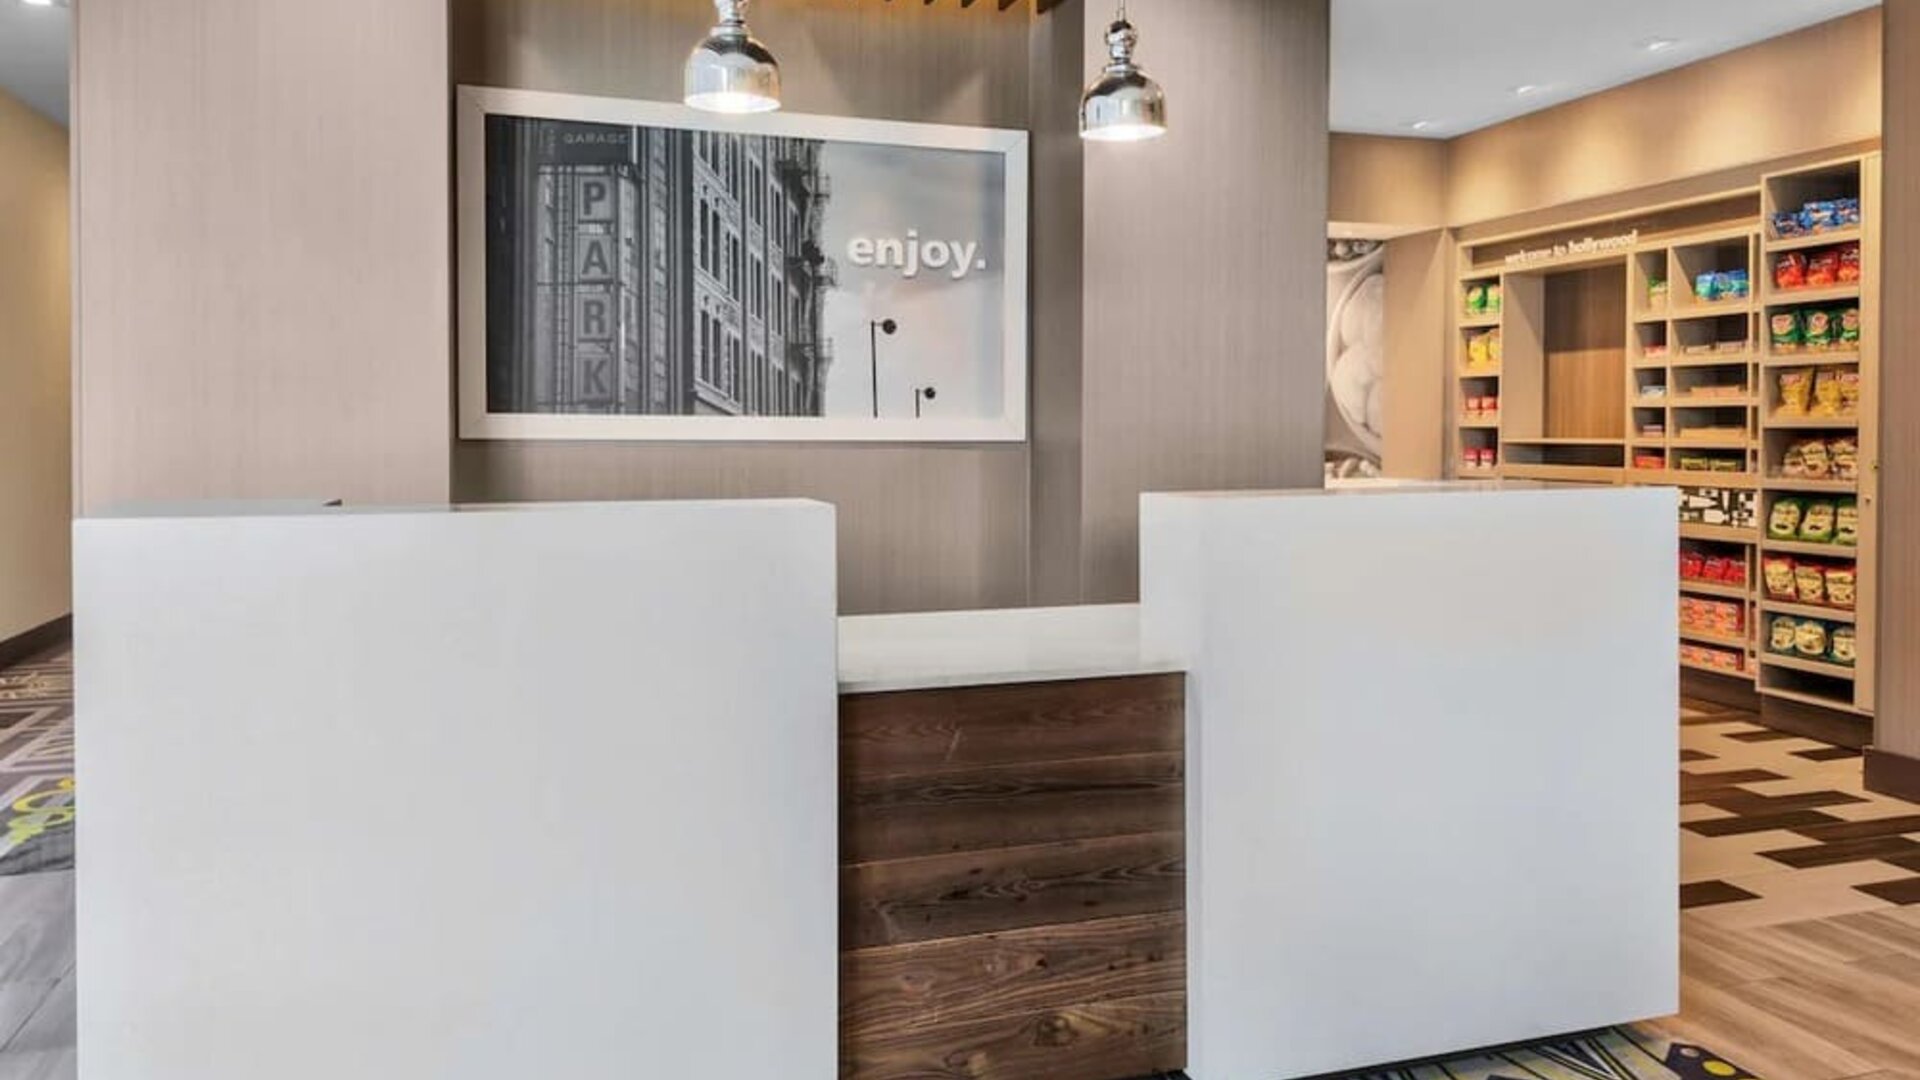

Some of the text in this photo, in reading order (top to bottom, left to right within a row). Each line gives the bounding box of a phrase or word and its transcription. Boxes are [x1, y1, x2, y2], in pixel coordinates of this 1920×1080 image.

[563, 132, 629, 145] GARAGE
[848, 228, 987, 279] enjoy.
[581, 180, 609, 395] PARK
